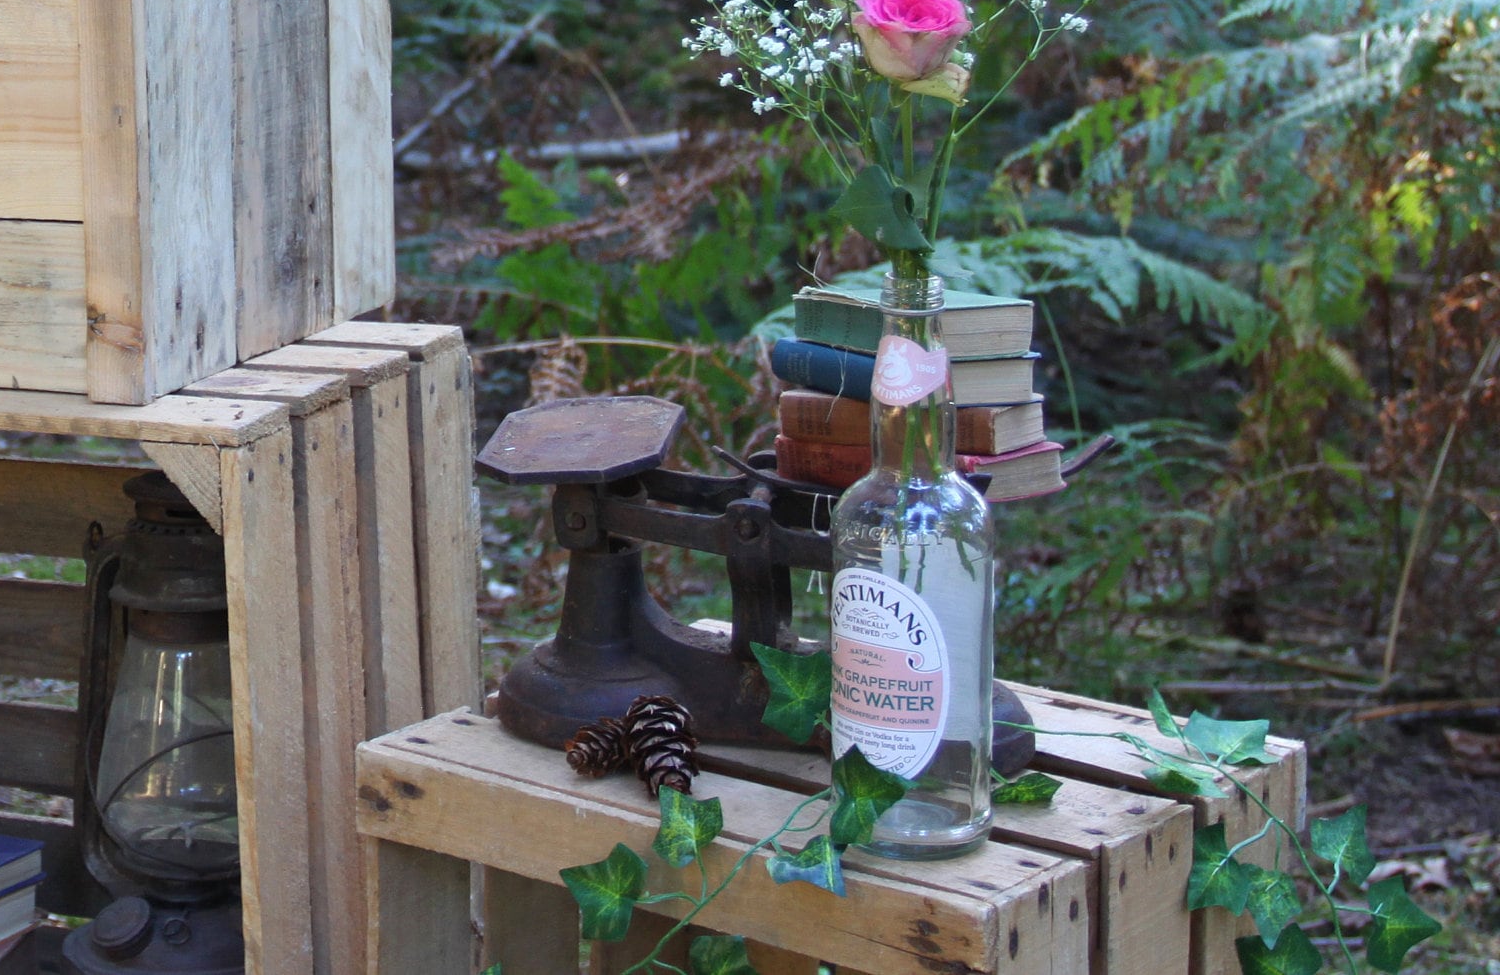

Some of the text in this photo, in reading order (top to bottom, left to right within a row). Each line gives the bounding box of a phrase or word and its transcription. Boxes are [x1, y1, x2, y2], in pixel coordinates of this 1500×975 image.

[915, 363, 937, 374] 1905
[875, 383, 923, 401] NTIMANS
[832, 584, 928, 646] FENTIMANS
[845, 614, 890, 630] BOTANICALLY
[852, 626, 880, 637] BREWED
[844, 669, 933, 692] GRAPEFRUIT
[833, 677, 860, 703] ONIC
[862, 689, 935, 711] WATER
[845, 707, 880, 720] GRAPEFRUIT
[882, 716, 897, 724] AND
[853, 735, 864, 743] and
[864, 740, 881, 749] zesty
[881, 741, 896, 751] long
[897, 743, 916, 751] drink
[872, 731, 893, 741] Vodka
[893, 734, 903, 742] for
